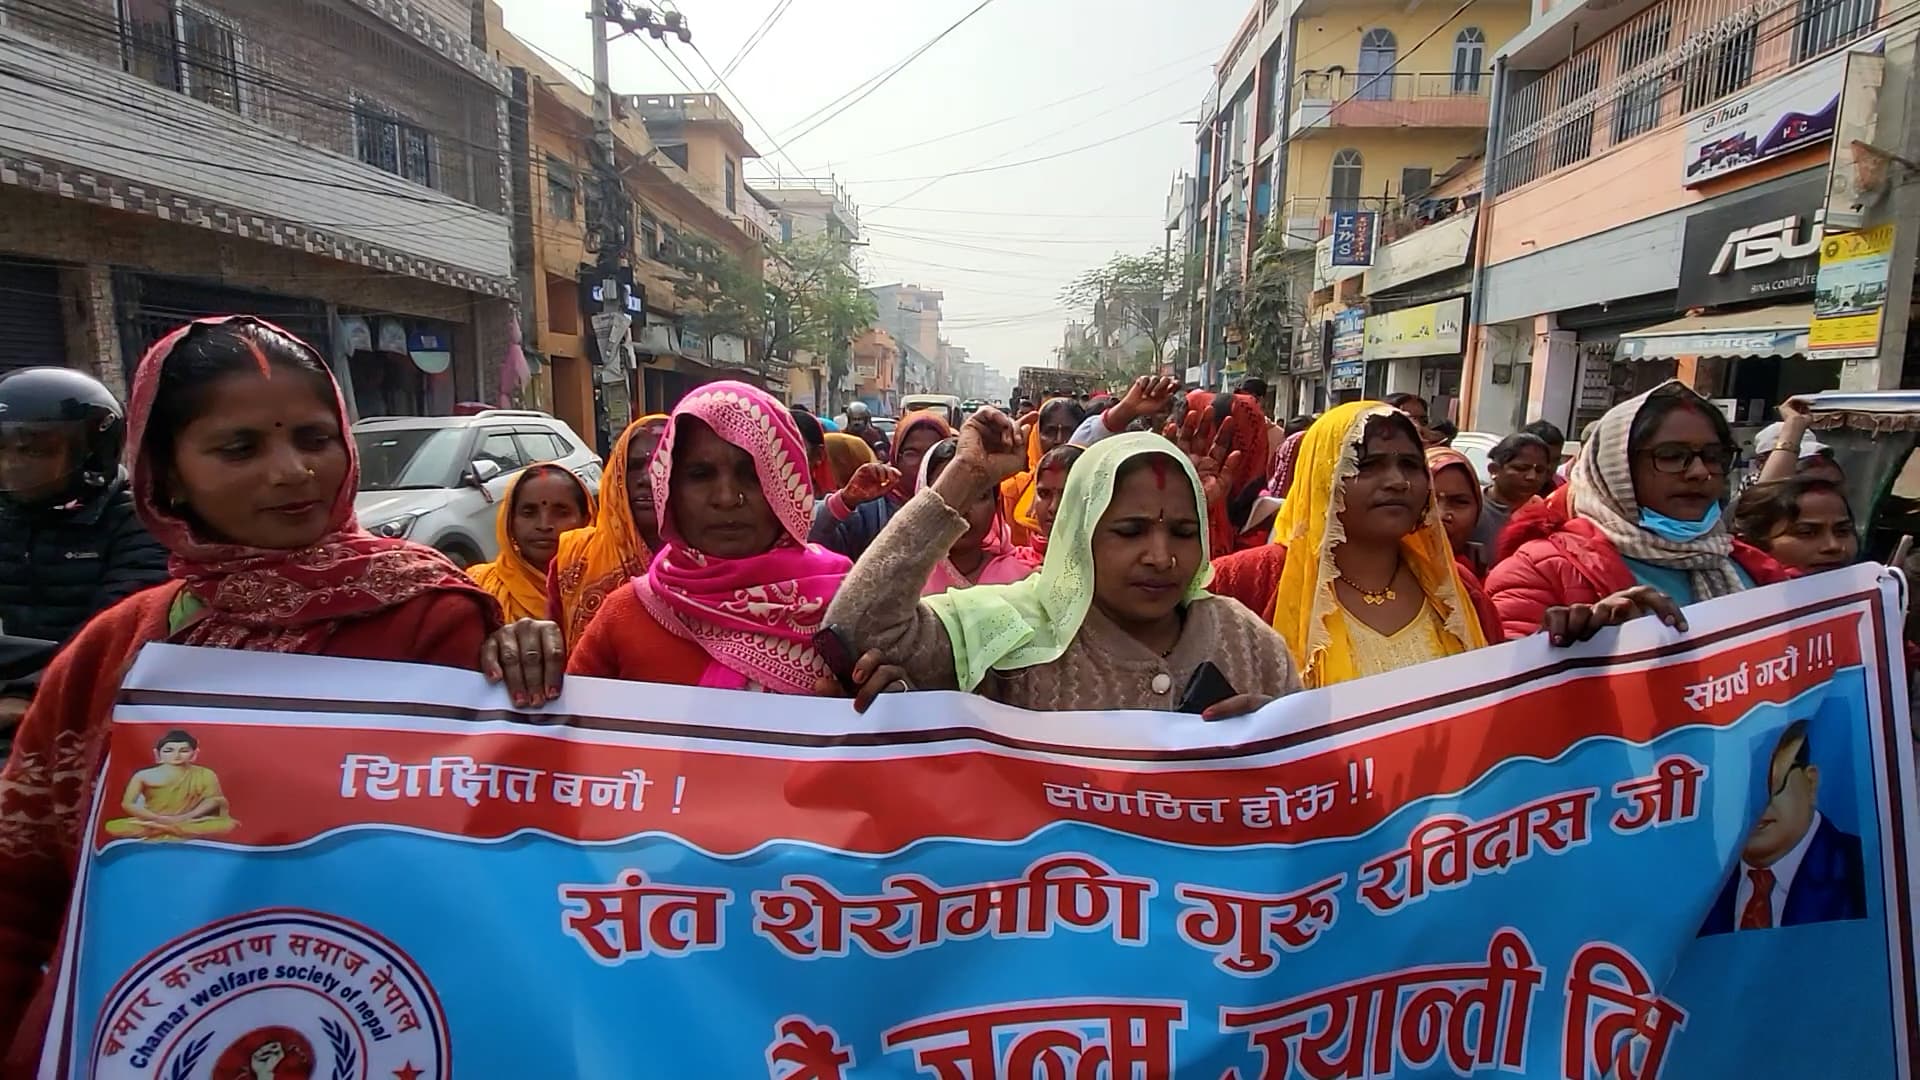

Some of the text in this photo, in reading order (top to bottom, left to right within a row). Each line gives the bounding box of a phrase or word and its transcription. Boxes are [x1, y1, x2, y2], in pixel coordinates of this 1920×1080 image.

[1709, 208, 1826, 275] ASU
[1772, 274, 1817, 290] COMPUTE
[1684, 661, 1749, 711] संघर्ष
[1807, 632, 1833, 671] !!!
[341, 754, 546, 806] शिक्षित
[671, 776, 686, 814] !
[1043, 782, 1230, 823] संगठित
[1349, 757, 1374, 805] !!
[561, 869, 732, 964] संत
[752, 853, 1154, 960] शेरोमणि
[1358, 788, 1600, 913] रविदास
[1611, 755, 1707, 834] जी
[103, 933, 421, 1056] चमार कल्याण समाज नेपाल
[129, 965, 392, 1069] Chamar welfare society of nepal
